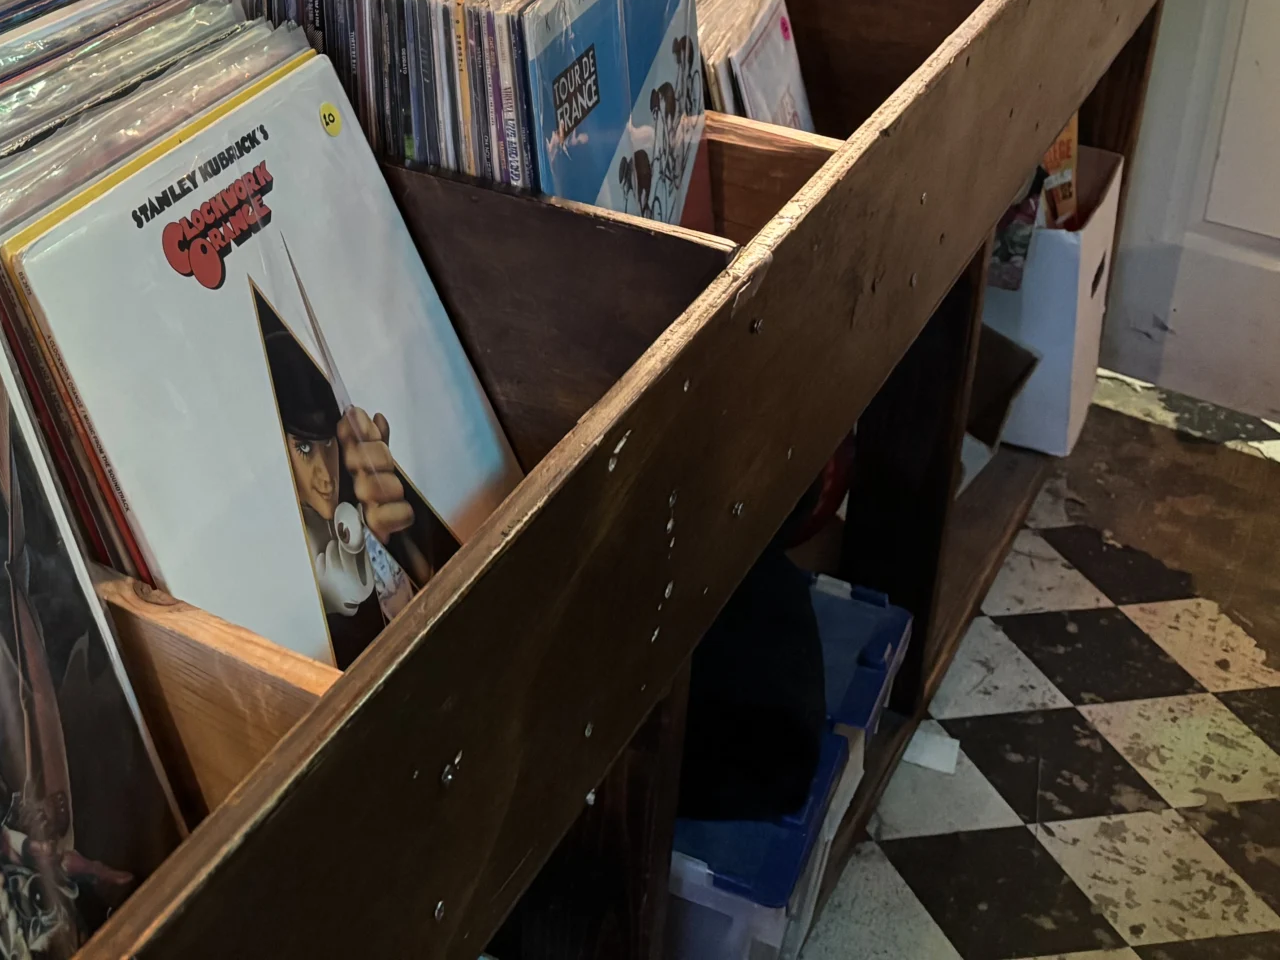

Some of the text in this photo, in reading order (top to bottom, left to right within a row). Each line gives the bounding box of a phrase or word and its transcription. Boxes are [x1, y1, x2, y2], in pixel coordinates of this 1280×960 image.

[554, 49, 596, 104] TOUR DE
[556, 81, 599, 130] FRANCE
[132, 124, 269, 229] STANLEY KUBRICK'S
[162, 160, 274, 277] CLOCKWORK
[188, 194, 271, 290] ORANGE
[49, 339, 131, 513] CLOCKWORK ORANGE MUSIC FROM THE SOUNDTRACK
